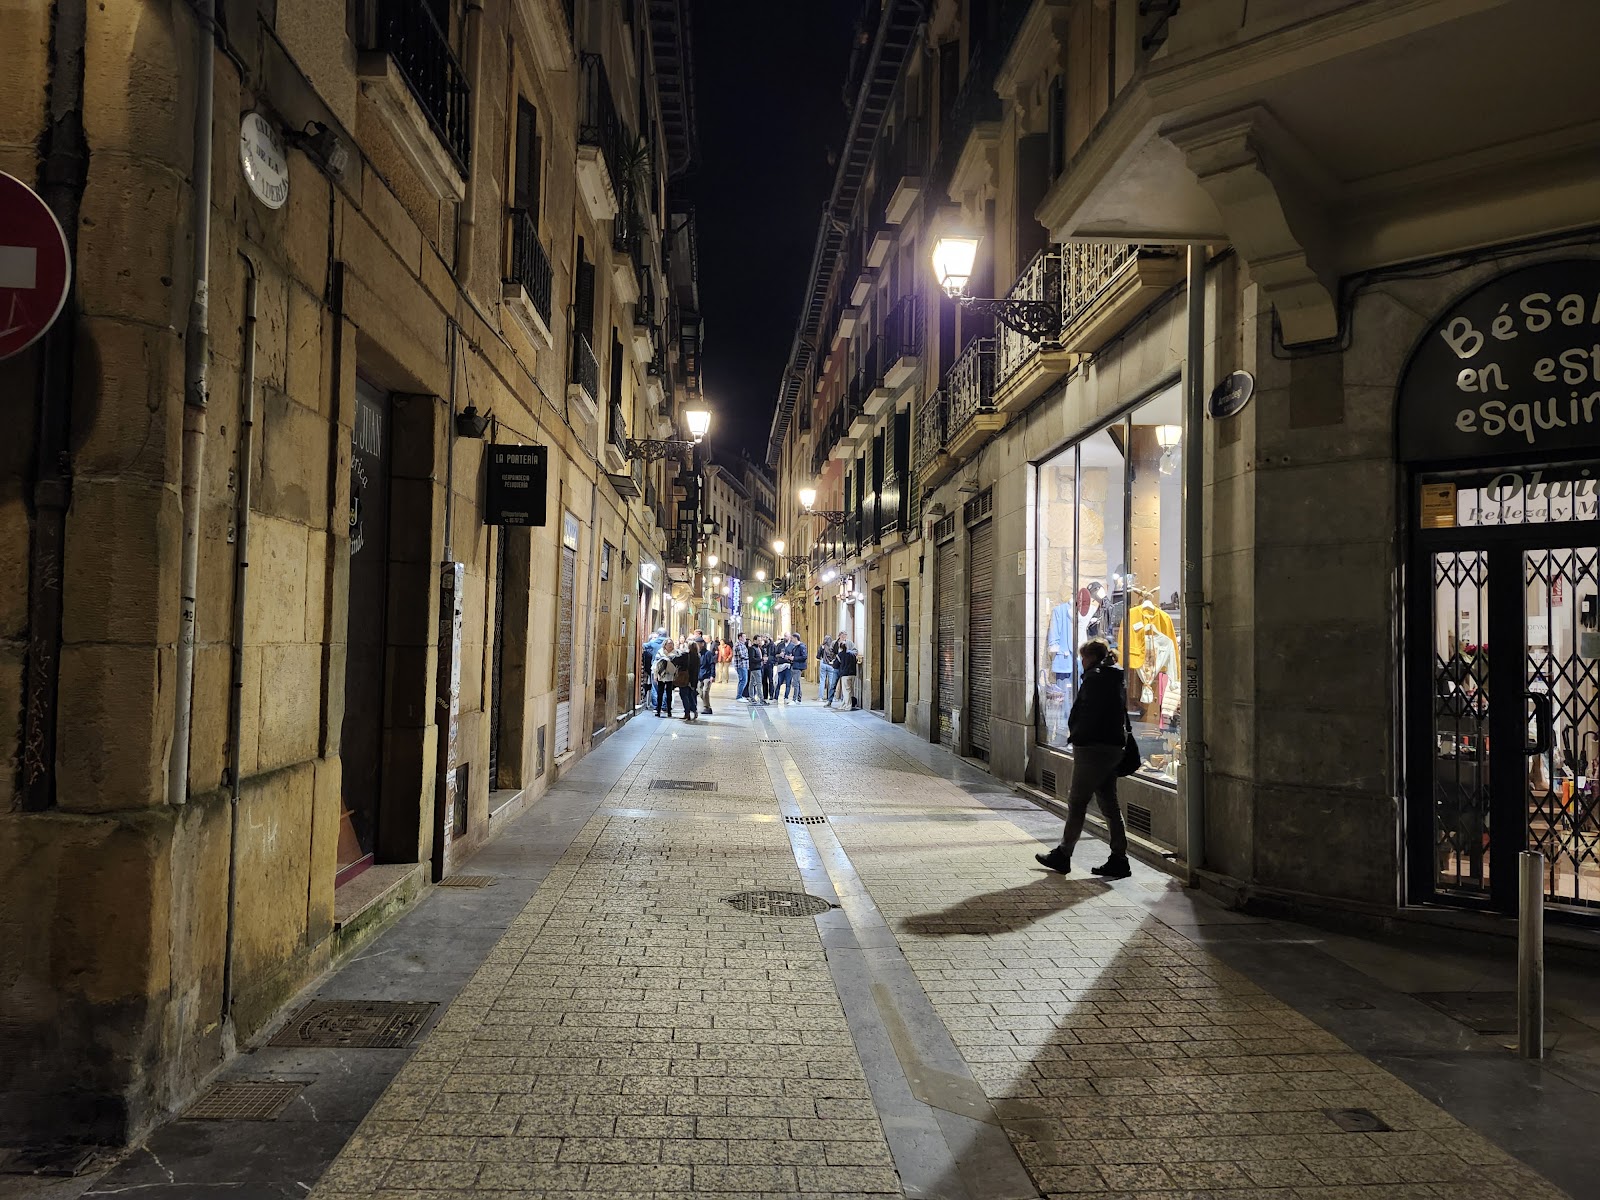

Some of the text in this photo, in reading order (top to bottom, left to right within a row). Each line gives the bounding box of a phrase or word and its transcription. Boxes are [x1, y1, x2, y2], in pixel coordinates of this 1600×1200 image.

[256, 144, 279, 175] DE LA
[1456, 362, 1509, 393] en
[359, 404, 382, 461] JUAN
[495, 452, 539, 465] LA PORTERÍA
[1467, 505, 1547, 521] Belleza
[1552, 507, 1568, 521] y
